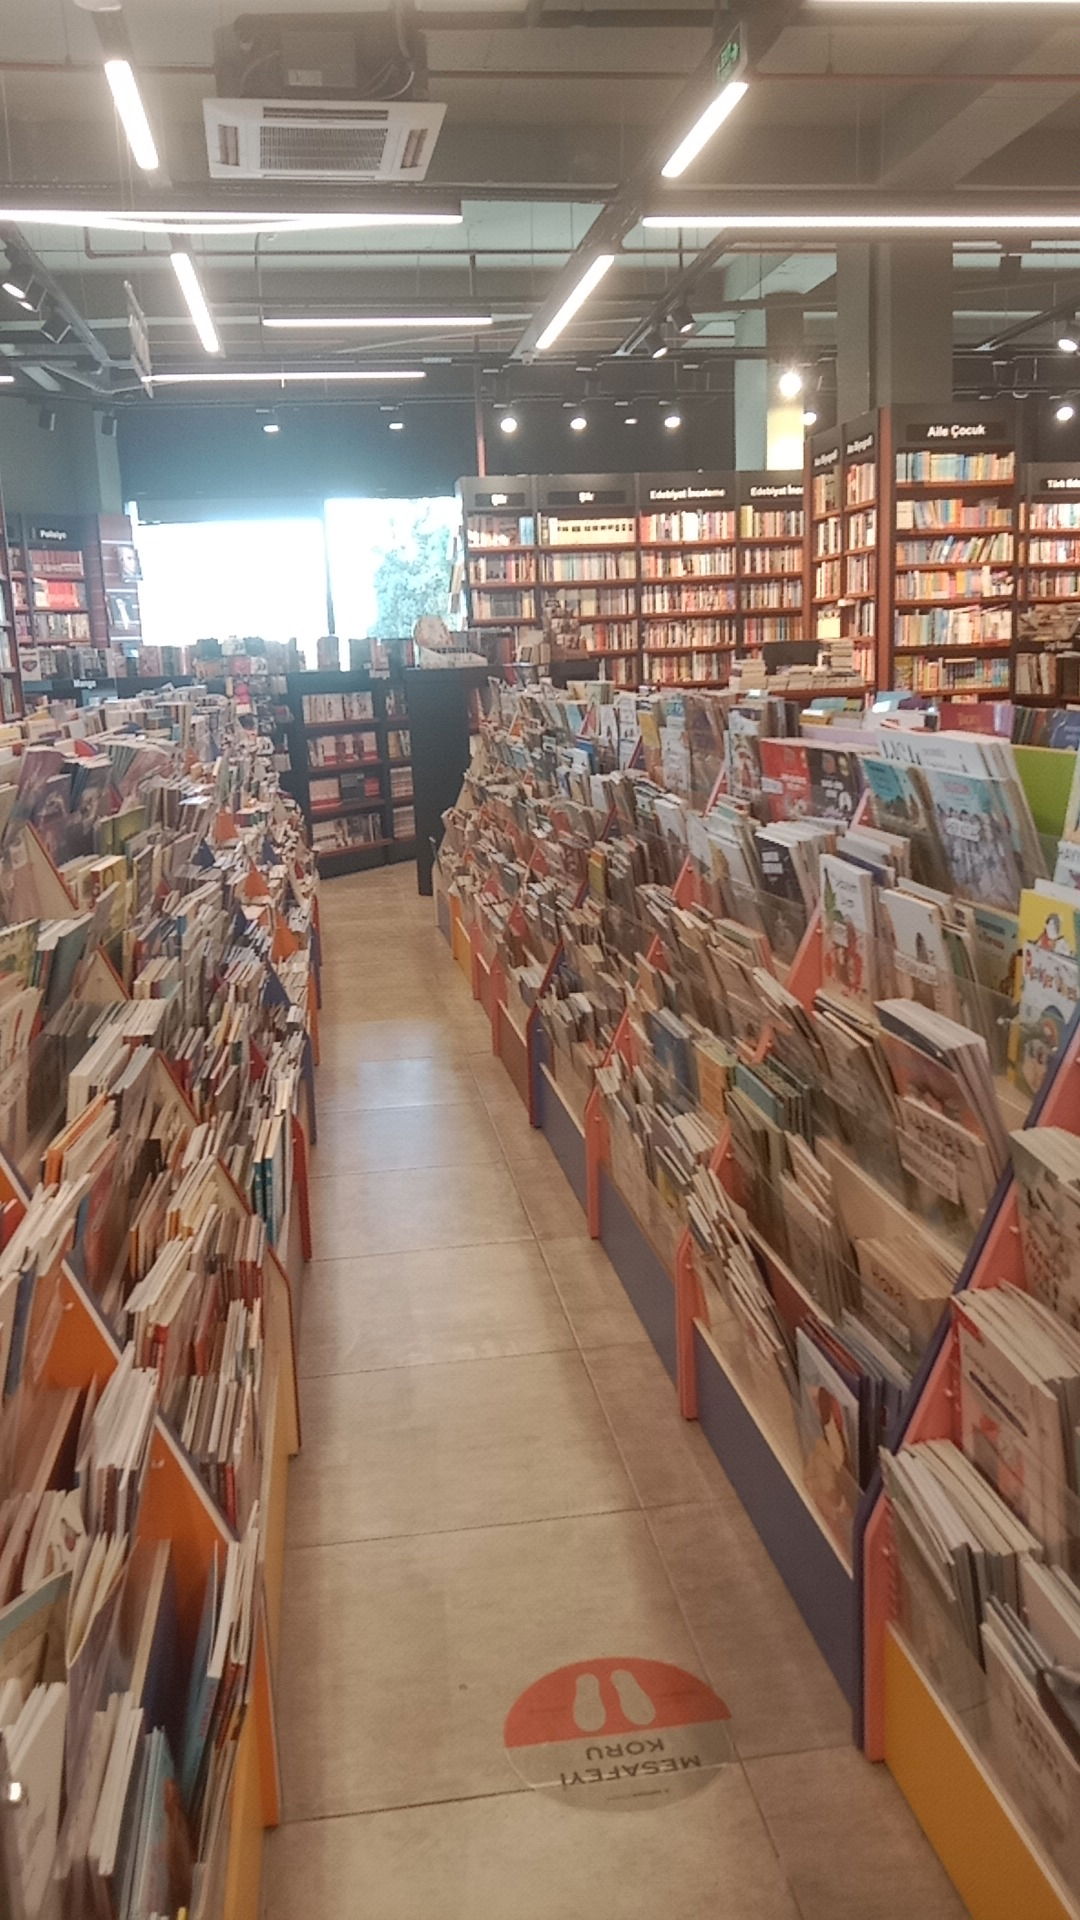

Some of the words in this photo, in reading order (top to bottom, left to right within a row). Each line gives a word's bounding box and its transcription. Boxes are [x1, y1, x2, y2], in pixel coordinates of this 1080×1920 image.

[927, 425, 948, 438] Aile
[951, 424, 986, 439] Çocuk
[586, 1738, 664, 1761] KORU
